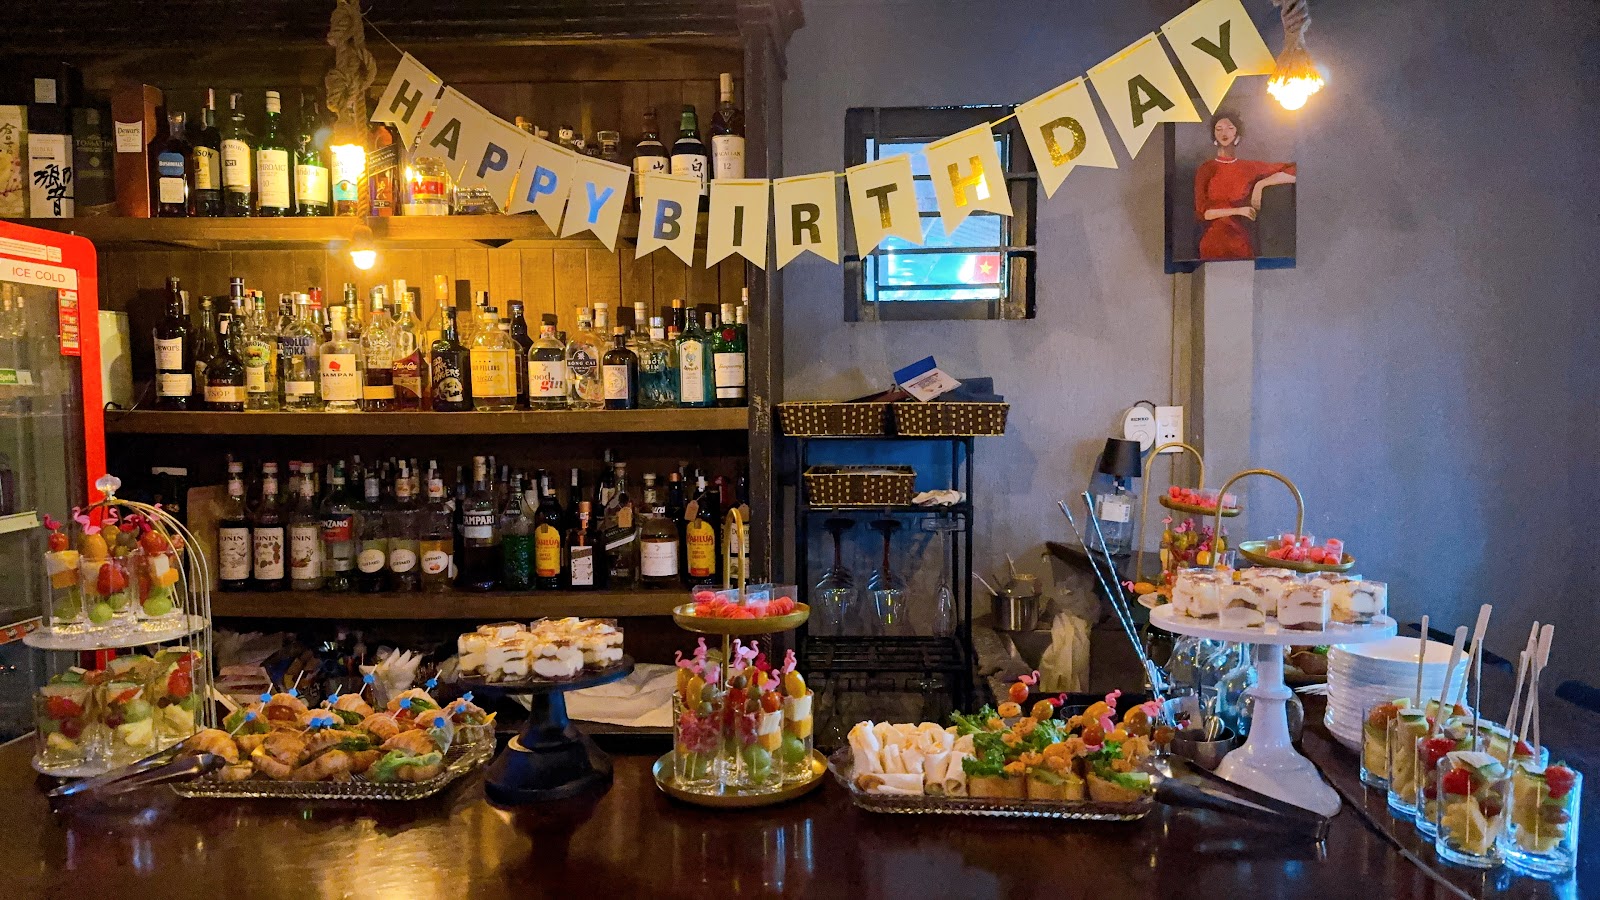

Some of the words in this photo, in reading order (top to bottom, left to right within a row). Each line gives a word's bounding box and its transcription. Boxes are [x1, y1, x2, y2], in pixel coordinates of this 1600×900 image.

[117, 127, 140, 135] Dewar's
[389, 78, 615, 226] HAPPY
[653, 20, 1236, 248] BIRTHDAY
[723, 162, 732, 170] 12
[12, 266, 31, 278] ICE
[35, 270, 66, 283] COLD
[540, 376, 563, 393] gin
